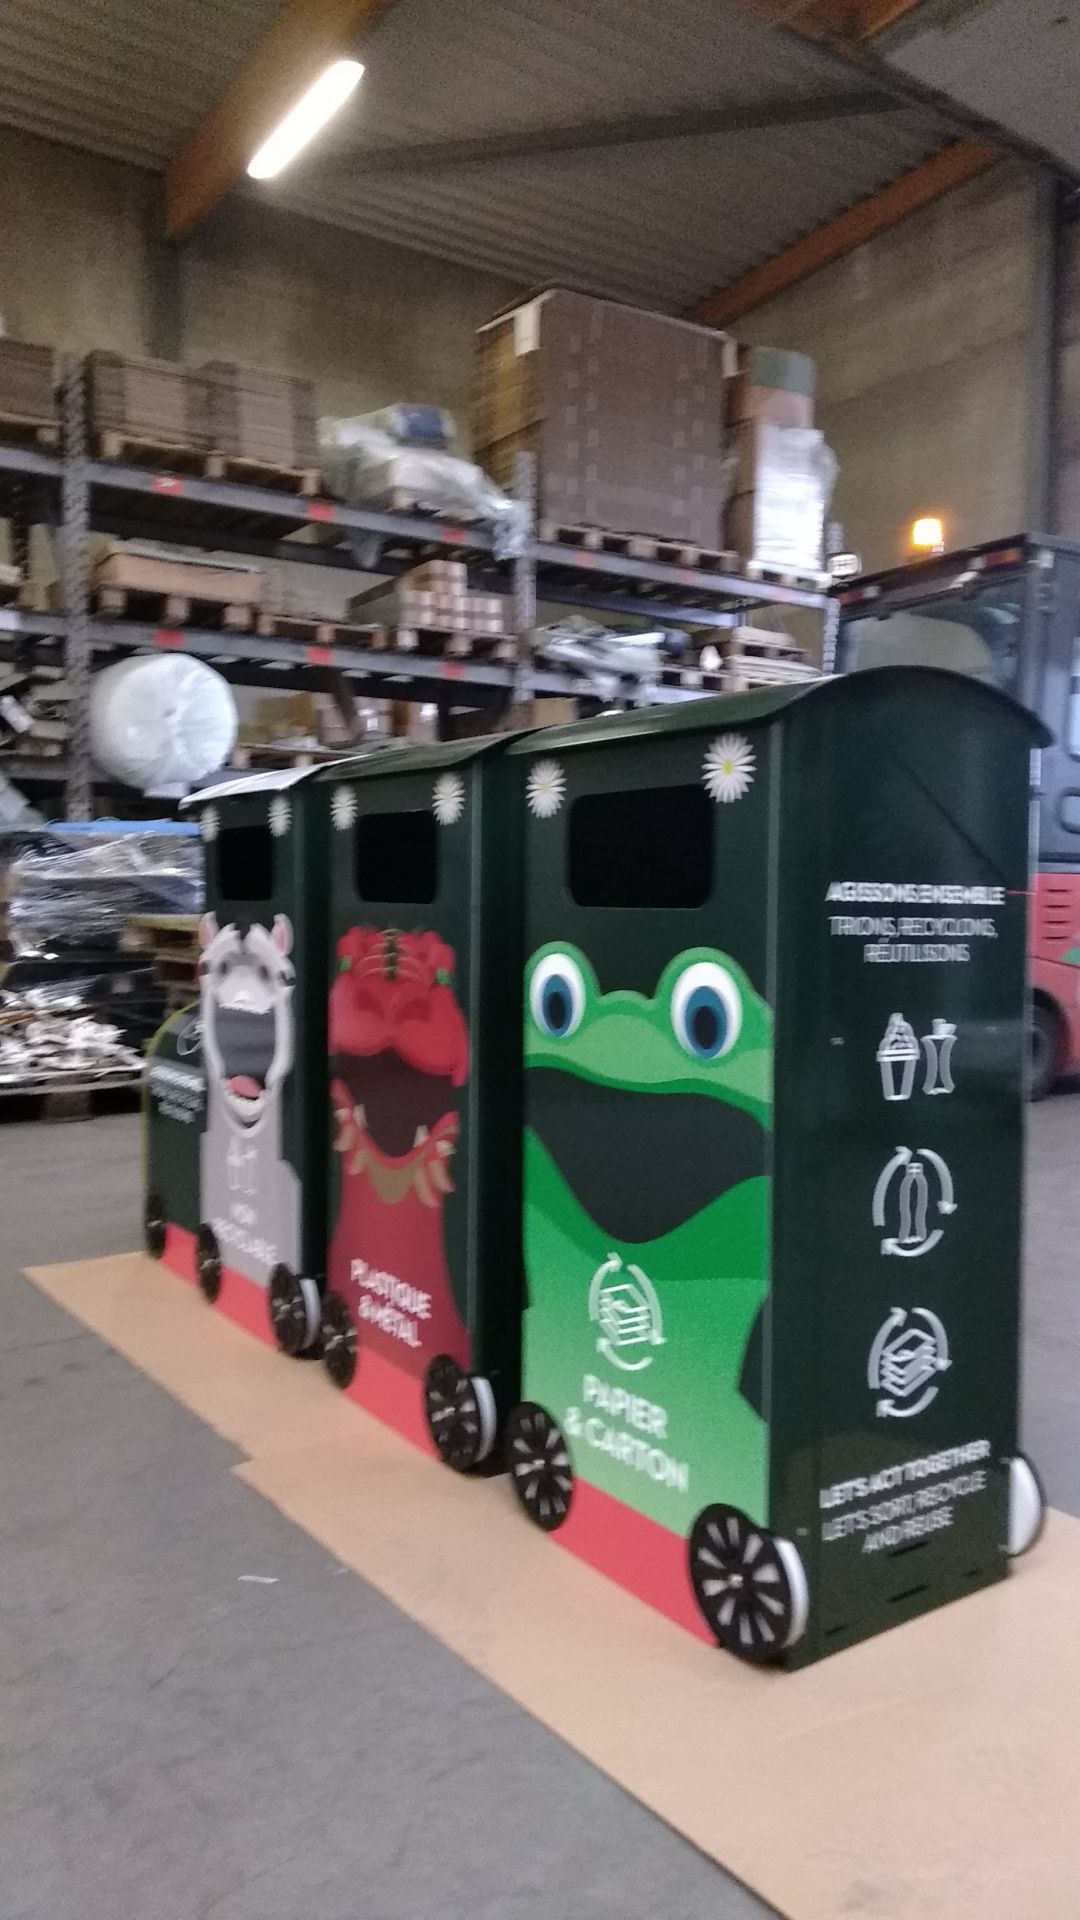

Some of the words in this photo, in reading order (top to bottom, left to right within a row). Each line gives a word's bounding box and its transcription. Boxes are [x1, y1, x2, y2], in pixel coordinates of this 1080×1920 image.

[825, 881, 918, 902] AGISSONS
[919, 884, 1006, 905] ENSEMBLE
[350, 1258, 432, 1319] PLASTIQUE
[583, 1374, 668, 1439] PAPIER
[563, 1406, 583, 1436] &
[585, 1417, 689, 1493] CARTON
[869, 1466, 903, 1493] ACT
[904, 1439, 991, 1481] TOGETHER
